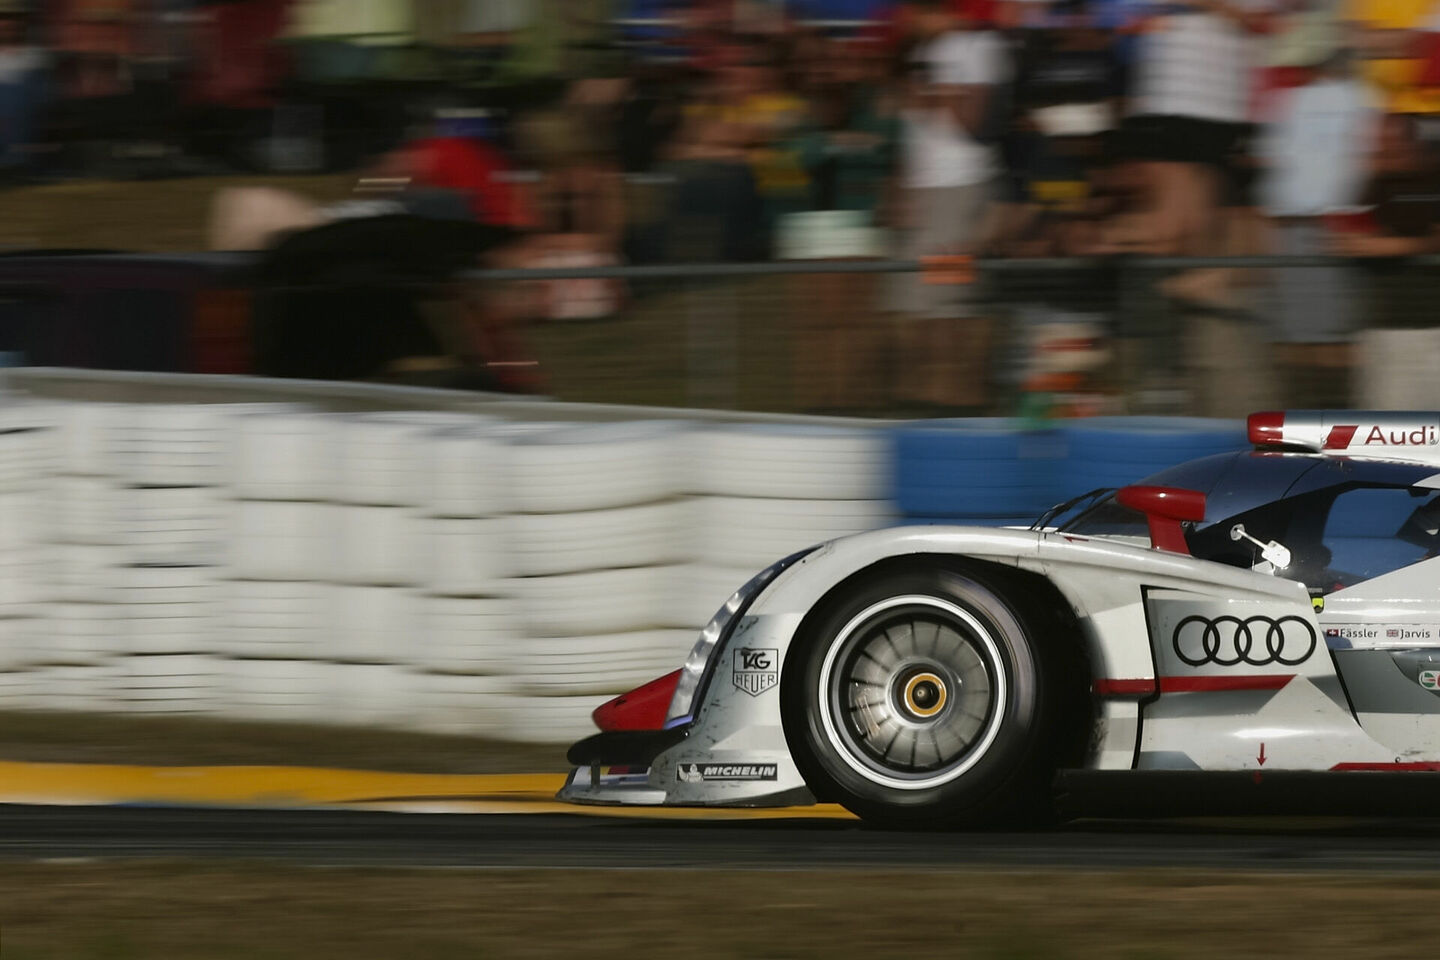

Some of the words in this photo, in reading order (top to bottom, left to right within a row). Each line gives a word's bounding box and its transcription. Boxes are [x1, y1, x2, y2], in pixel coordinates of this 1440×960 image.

[1364, 425, 1435, 446] Audi
[1340, 628, 1378, 639] Fässler
[1400, 628, 1431, 639] Jarvis
[741, 647, 771, 669] TAG
[735, 674, 775, 693] HEUER
[703, 766, 776, 776] MICHELIN
